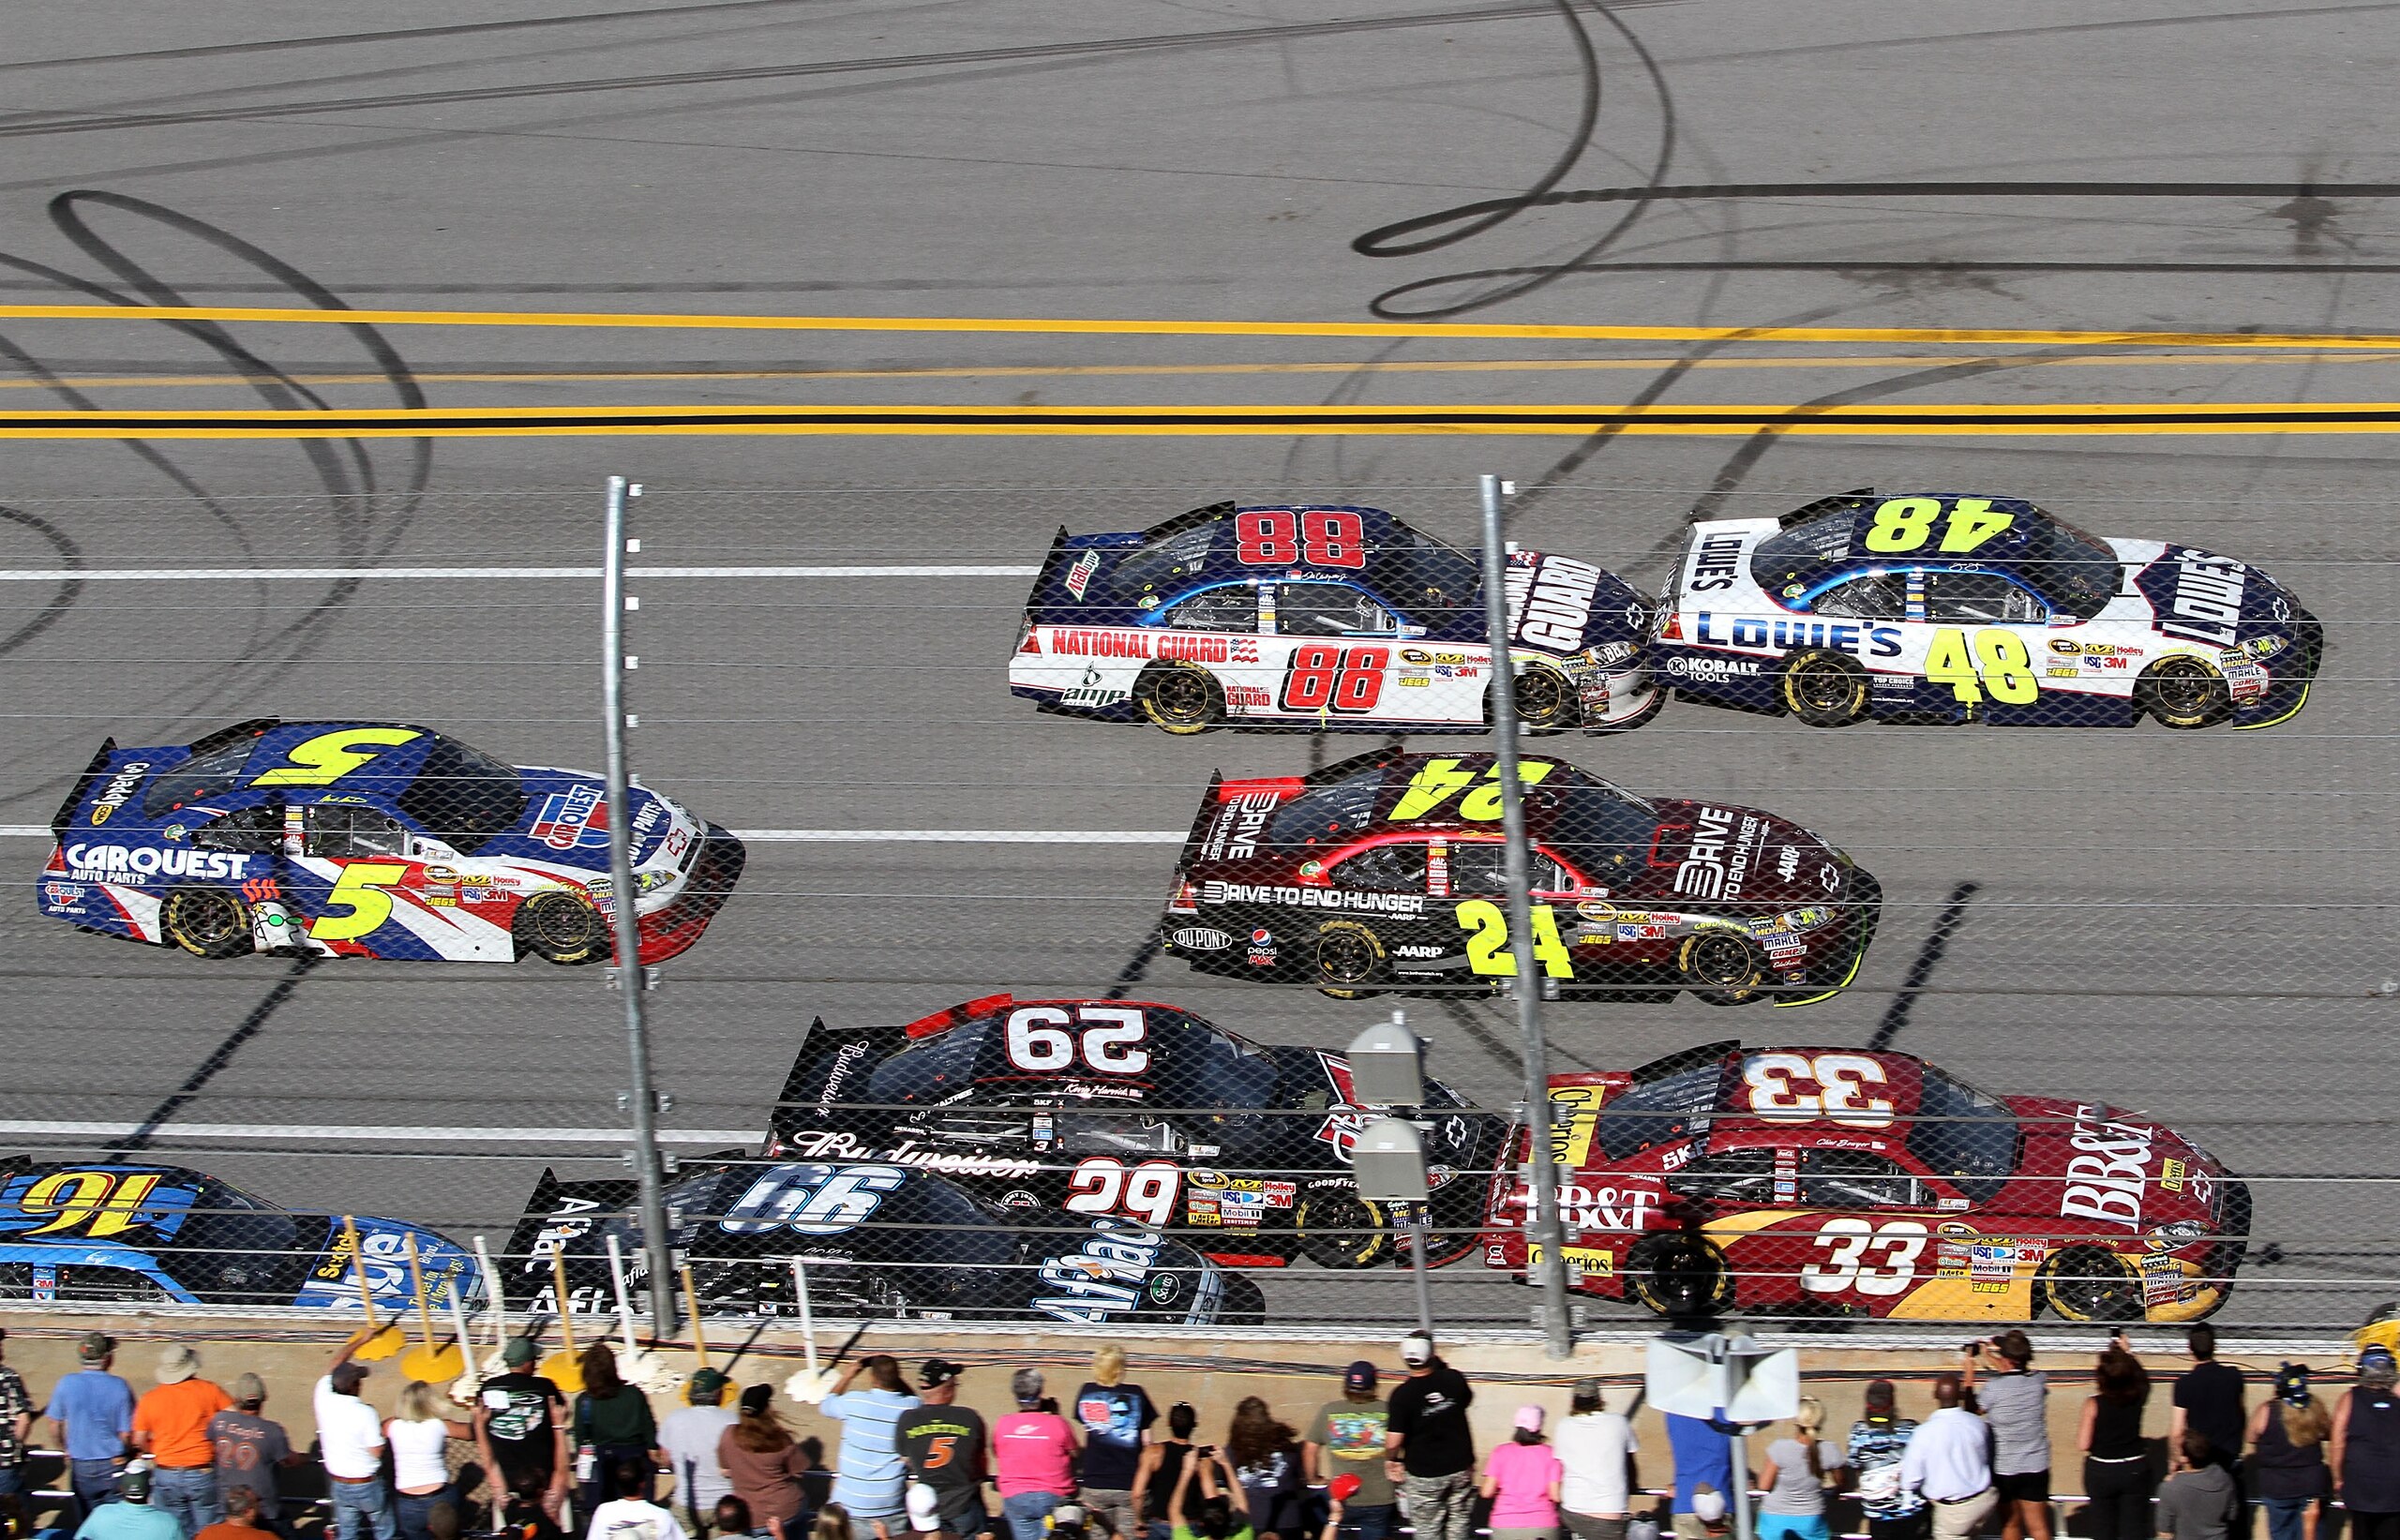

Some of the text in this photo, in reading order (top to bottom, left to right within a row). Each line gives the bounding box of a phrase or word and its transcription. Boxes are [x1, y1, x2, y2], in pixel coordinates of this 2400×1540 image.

[1865, 498, 2015, 552] 48
[1236, 511, 1366, 569] 88
[1690, 531, 1750, 591] LOWE'S
[1521, 556, 1601, 651] GUARD
[2162, 548, 2246, 647] LOWE'S
[1698, 611, 1902, 657] LOWE'S
[1053, 629, 1227, 664] NATIONAL GUARD
[1688, 658, 1760, 676] KOBALT
[1924, 628, 2040, 705] 48
[2104, 657, 2127, 668] 3M
[1279, 642, 1391, 712] 88
[1455, 666, 1478, 678] 3M
[1690, 672, 1730, 683] TOOLS
[2047, 667, 2078, 678] JEGS
[2228, 667, 2261, 679] MAHLE
[1400, 678, 1430, 687] JEGS
[1063, 688, 1126, 707] amp
[1226, 692, 1270, 706] GUARD
[245, 727, 424, 788] 5
[545, 785, 604, 849] CARQUEST
[634, 800, 662, 831] PARTS
[1208, 793, 1244, 861] TO END HUNGER
[66, 843, 251, 880] CARQUEST
[1723, 815, 1760, 901] TO END HUNGER
[1778, 844, 1800, 883] AARP
[70, 869, 146, 885] AUTO PARTS
[45, 884, 85, 898] CARQUEST
[484, 888, 507, 901] 3M
[308, 862, 409, 940] 5
[425, 897, 458, 907] JEGS
[1274, 887, 1298, 905] TO
[1301, 888, 1341, 908] END
[1342, 892, 1424, 913] HUNGER
[1651, 913, 1681, 924] Holley
[1619, 925, 1637, 938] USG
[1639, 925, 1665, 938] 3M
[1754, 926, 1788, 936] MOOG
[1579, 934, 1612, 946] JEGS
[1763, 935, 1800, 949] MAHLE
[1247, 947, 1278, 958] pepsi
[1392, 945, 1442, 958] AARP
[1772, 948, 1798, 958] COMP
[1249, 955, 1276, 965] MAX
[1006, 1008, 1148, 1074] 29
[1744, 1054, 1895, 1126] 33
[1034, 1142, 1048, 1152] 3
[1662, 1137, 1710, 1171] SKF
[2061, 1104, 2153, 1234] BB&T
[1265, 1181, 1296, 1192] Holley
[1308, 1177, 1359, 1189] GOODYEA
[1062, 1155, 1182, 1230] 29
[1222, 1190, 1241, 1204] USG
[1266, 1193, 1292, 1207] 3M
[1800, 1219, 1928, 1295] 33
[1972, 1247, 1991, 1260] USG
[2018, 1249, 2045, 1262] 3M
[35, 1279, 53, 1288] 3M
[1972, 1283, 2009, 1293] JEGS
[215, 1437, 259, 1472] 29
[923, 1436, 957, 1469] 5
